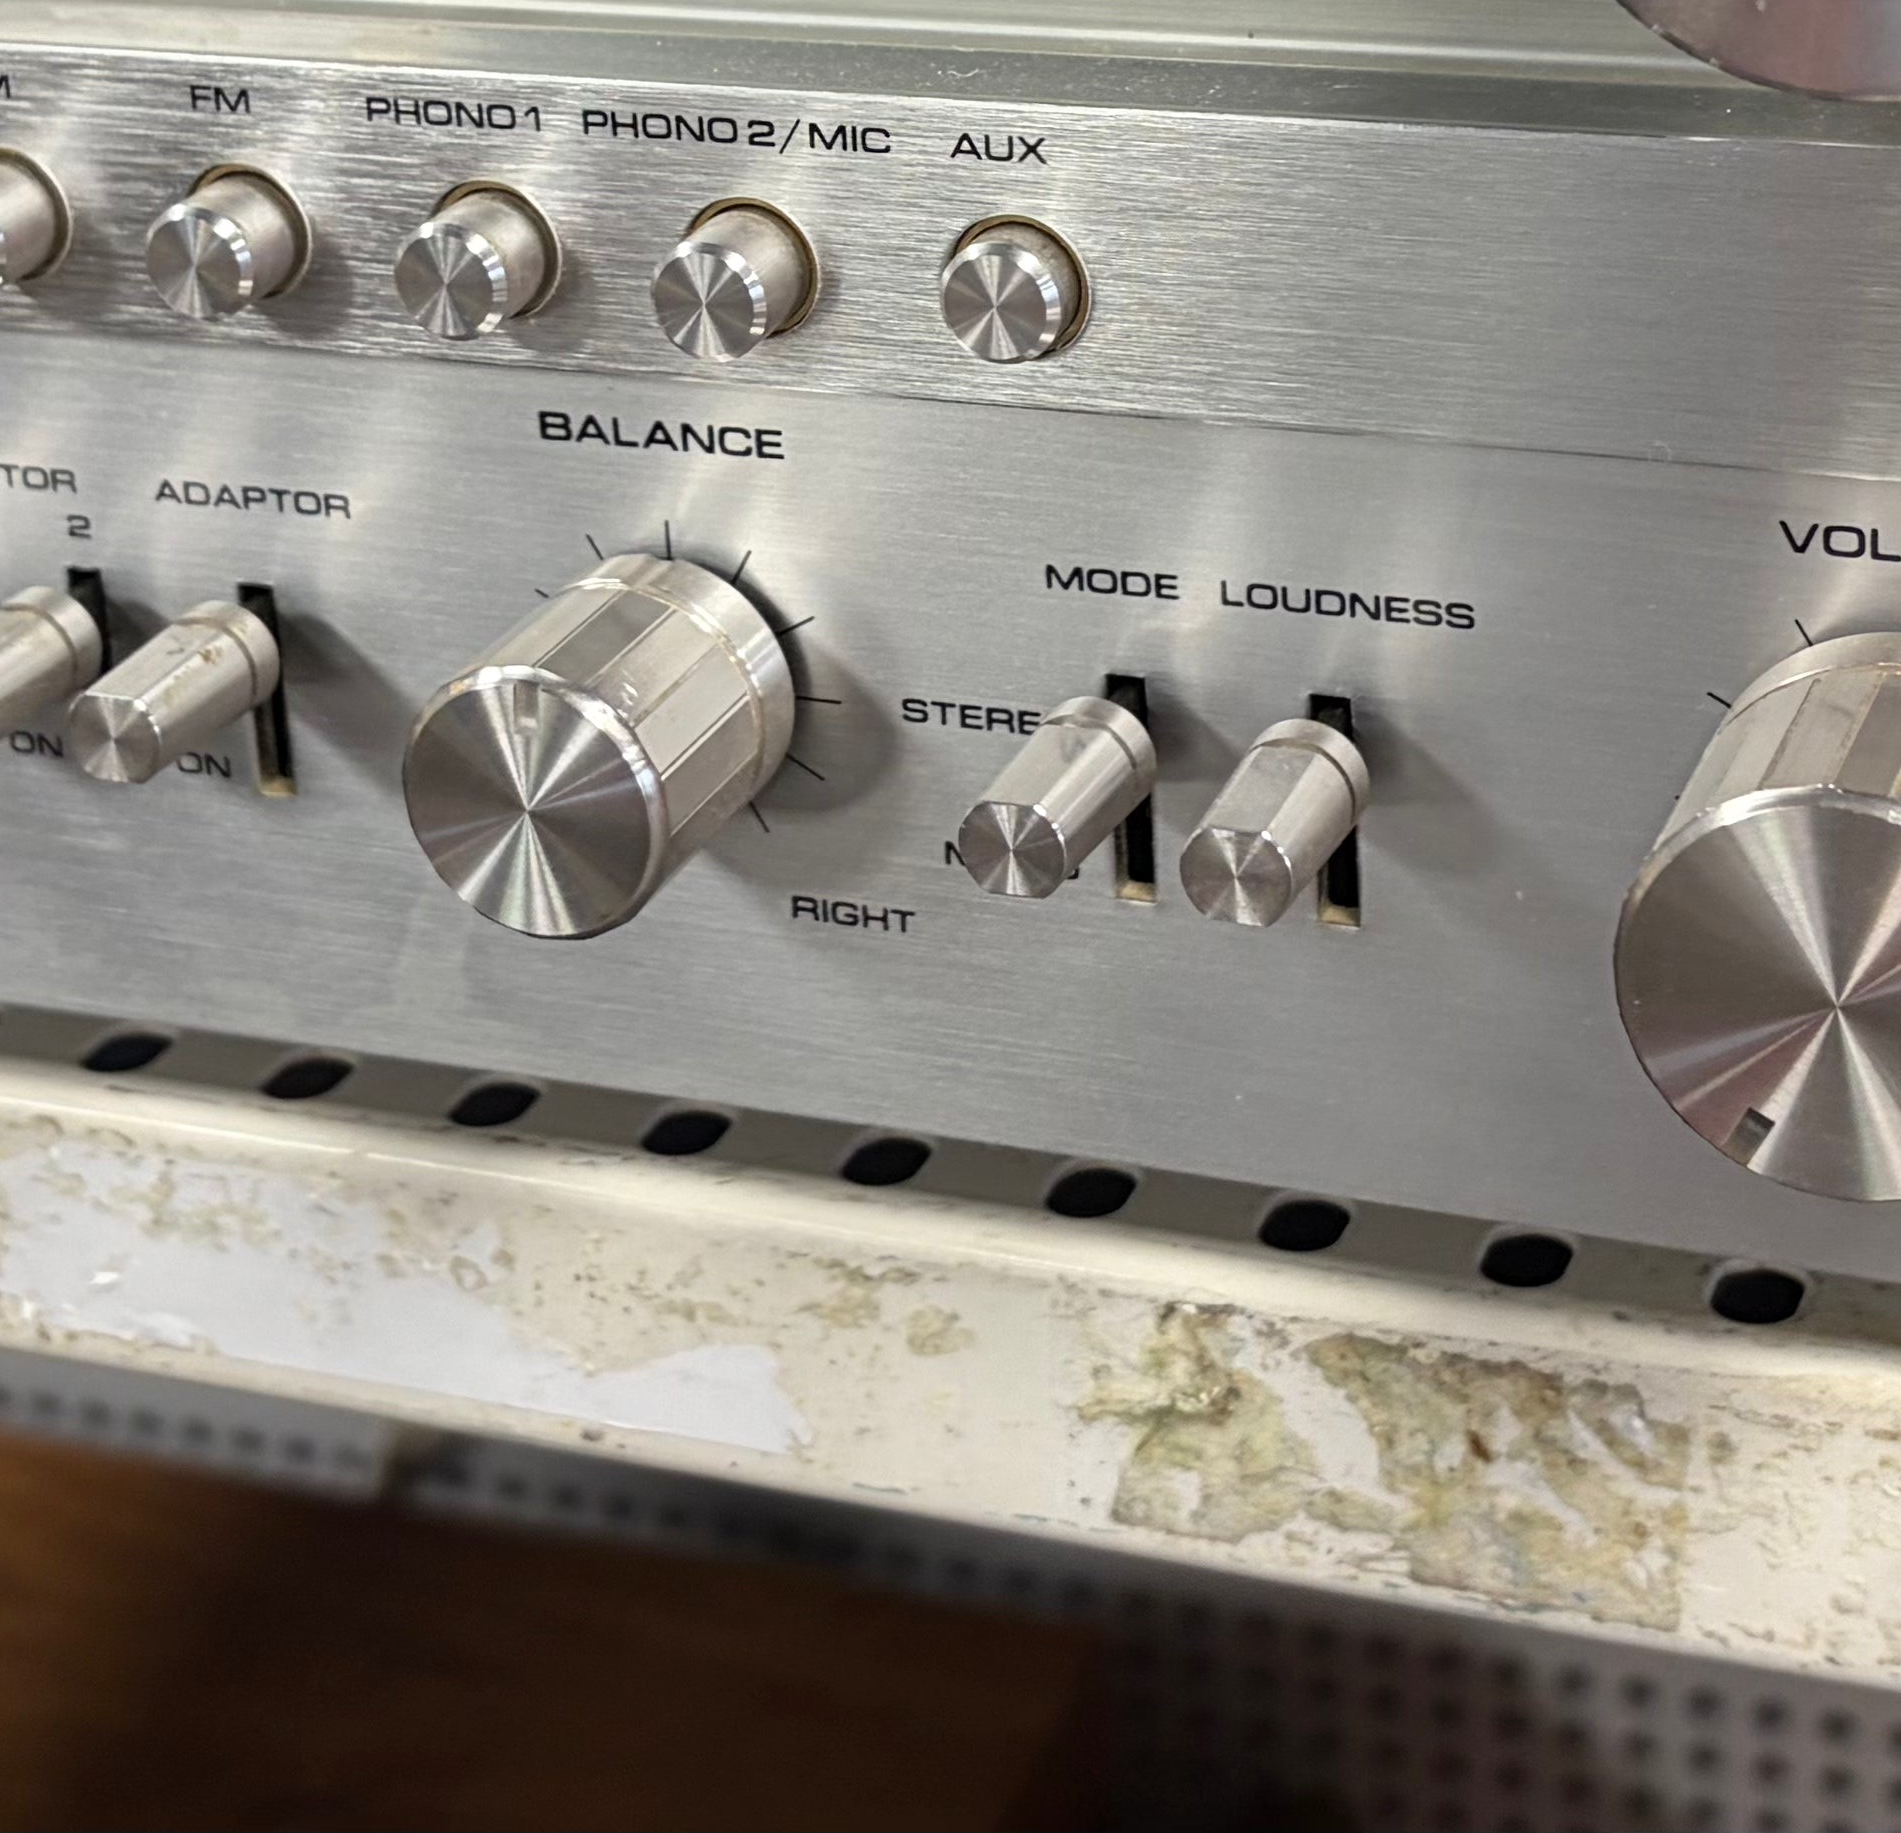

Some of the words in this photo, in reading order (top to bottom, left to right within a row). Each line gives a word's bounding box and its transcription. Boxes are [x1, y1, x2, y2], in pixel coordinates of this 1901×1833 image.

[190, 85, 251, 114] FM
[950, 135, 1047, 164] AUX
[538, 411, 785, 459] BALANCE
[155, 478, 352, 519] ADAPTOR
[67, 514, 91, 539] 2
[1045, 564, 1180, 600] MODE
[1220, 580, 1476, 630] LOUDNESS
[901, 698, 1041, 736] STERE
[10, 730, 64, 758] ON
[176, 751, 232, 779] ON
[791, 895, 916, 933] RIGHT
